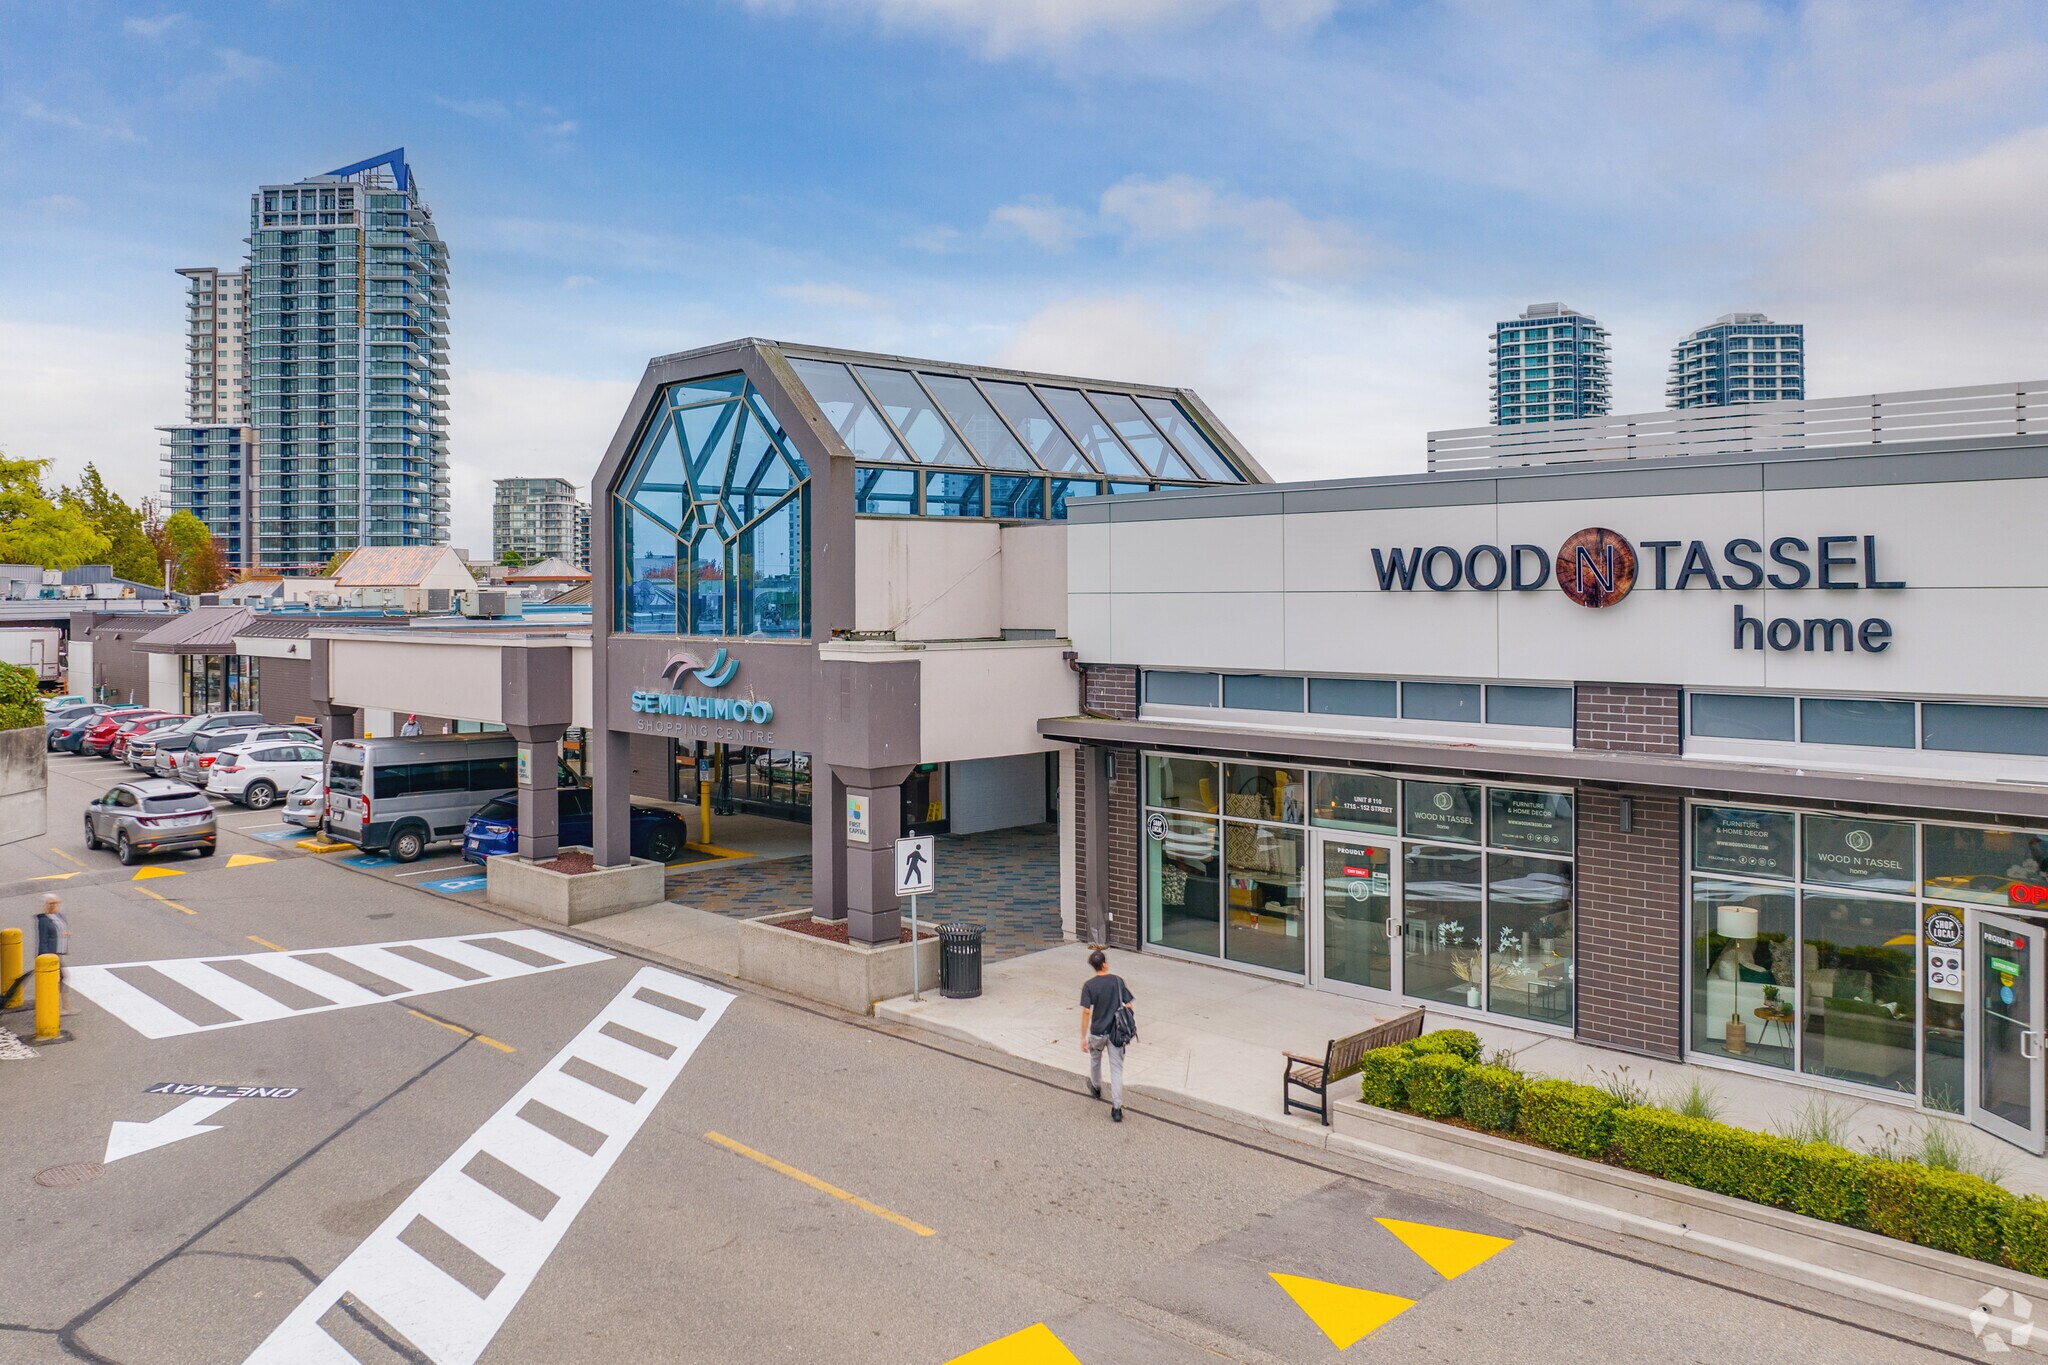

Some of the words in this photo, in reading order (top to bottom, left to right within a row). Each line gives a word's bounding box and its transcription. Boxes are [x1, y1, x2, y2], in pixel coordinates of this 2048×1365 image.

[1371, 544, 1550, 592] WOOD
[1575, 544, 1615, 593] N
[1640, 535, 1906, 590] TASSEL
[1733, 604, 1893, 653] home
[631, 691, 774, 724] SEMIAHMOO
[637, 719, 708, 737] SHOPPING
[716, 726, 775, 744] CENTRE
[1512, 801, 1544, 809] FURNITURE
[1414, 812, 1438, 820] WOOD
[1446, 815, 1474, 824] TASSEL
[1722, 820, 1760, 829] FURNITURE
[848, 828, 867, 836] CAPITAL
[1337, 848, 1365, 856] PROUDLY
[1818, 853, 1850, 864] WOOD
[1854, 857, 1861, 865] N
[1864, 858, 1903, 870] TASSEL
[1850, 868, 1868, 876] home
[2010, 884, 2048, 904] OP
[1934, 920, 1954, 930] SHOP
[1934, 928, 1956, 939] LOCAL
[1984, 932, 2014, 948] PROUDLY
